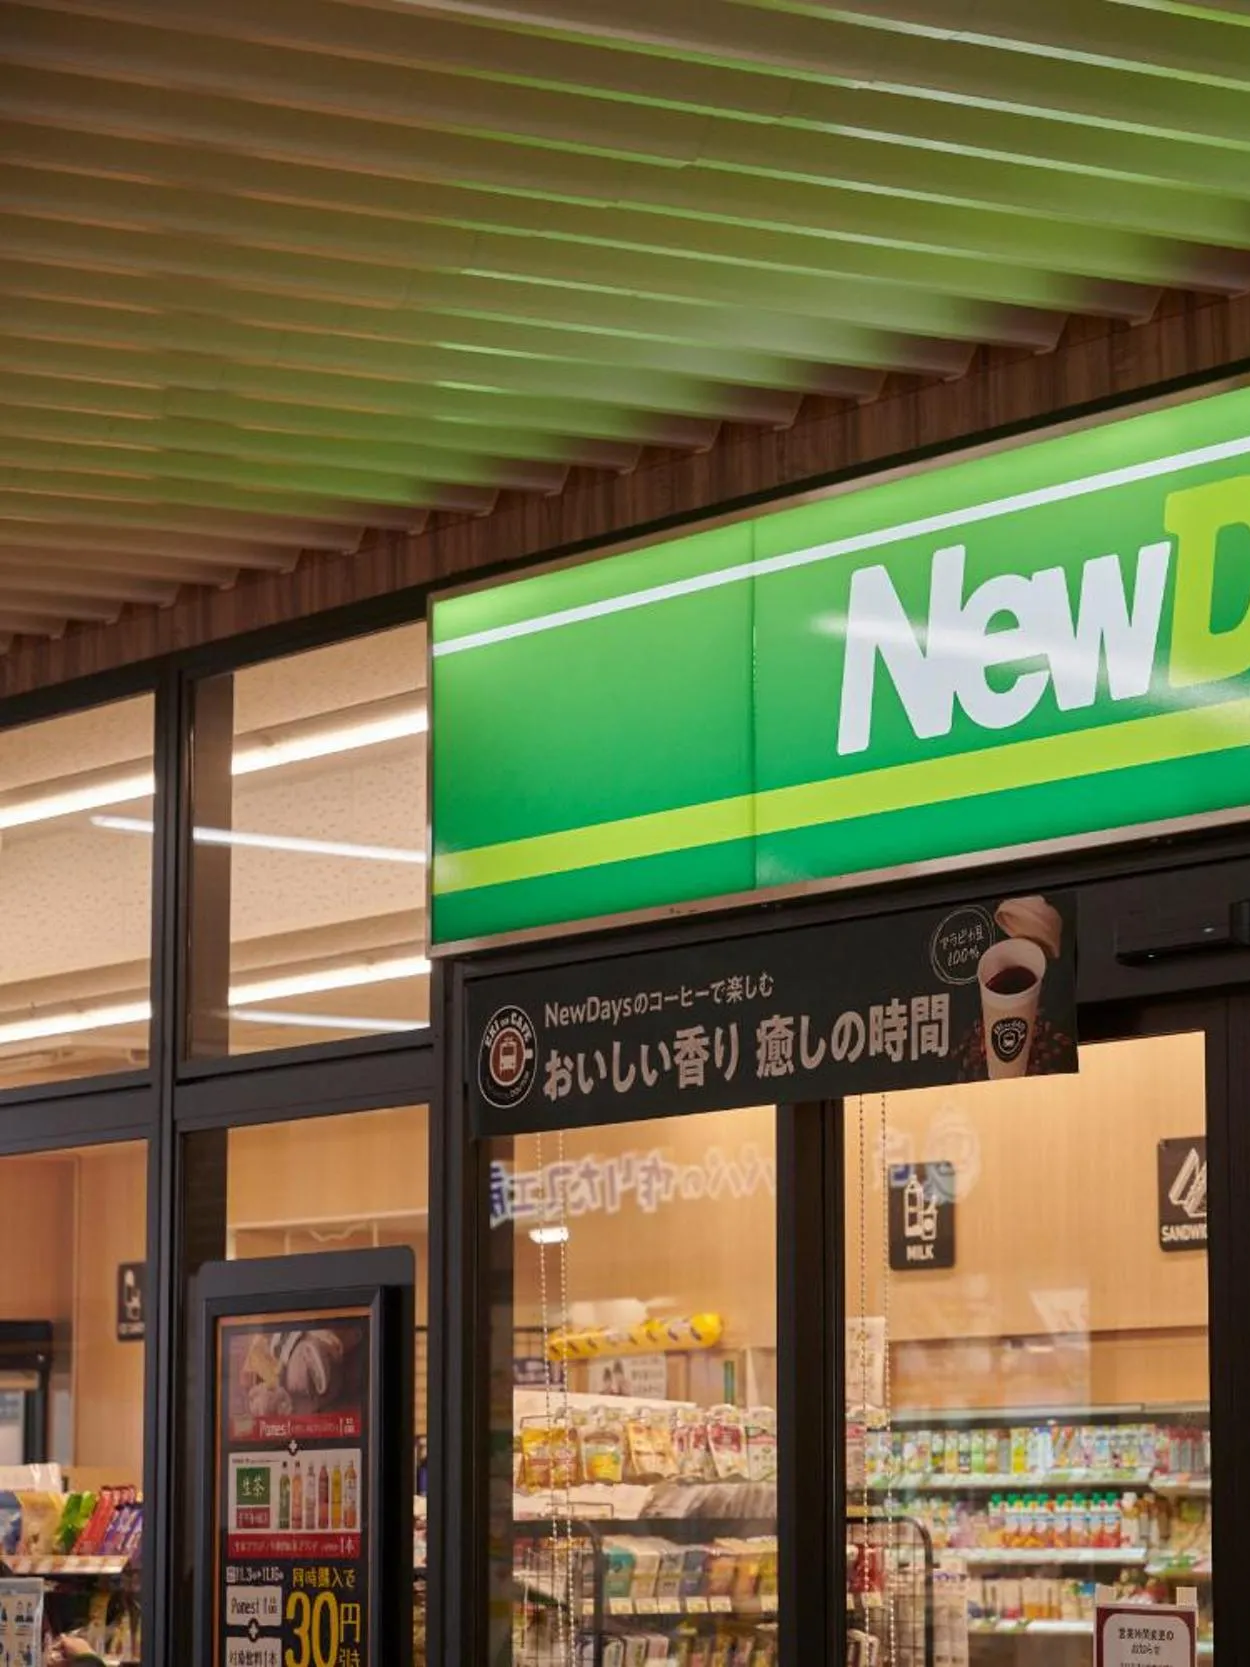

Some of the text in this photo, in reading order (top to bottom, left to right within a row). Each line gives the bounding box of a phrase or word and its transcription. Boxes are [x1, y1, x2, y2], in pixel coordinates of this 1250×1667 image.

[544, 971, 775, 1029] NewDaysのコーヒーで楽しむ
[542, 992, 951, 1101] おいしい香り 癒しの時間
[906, 1244, 935, 1261] MILK
